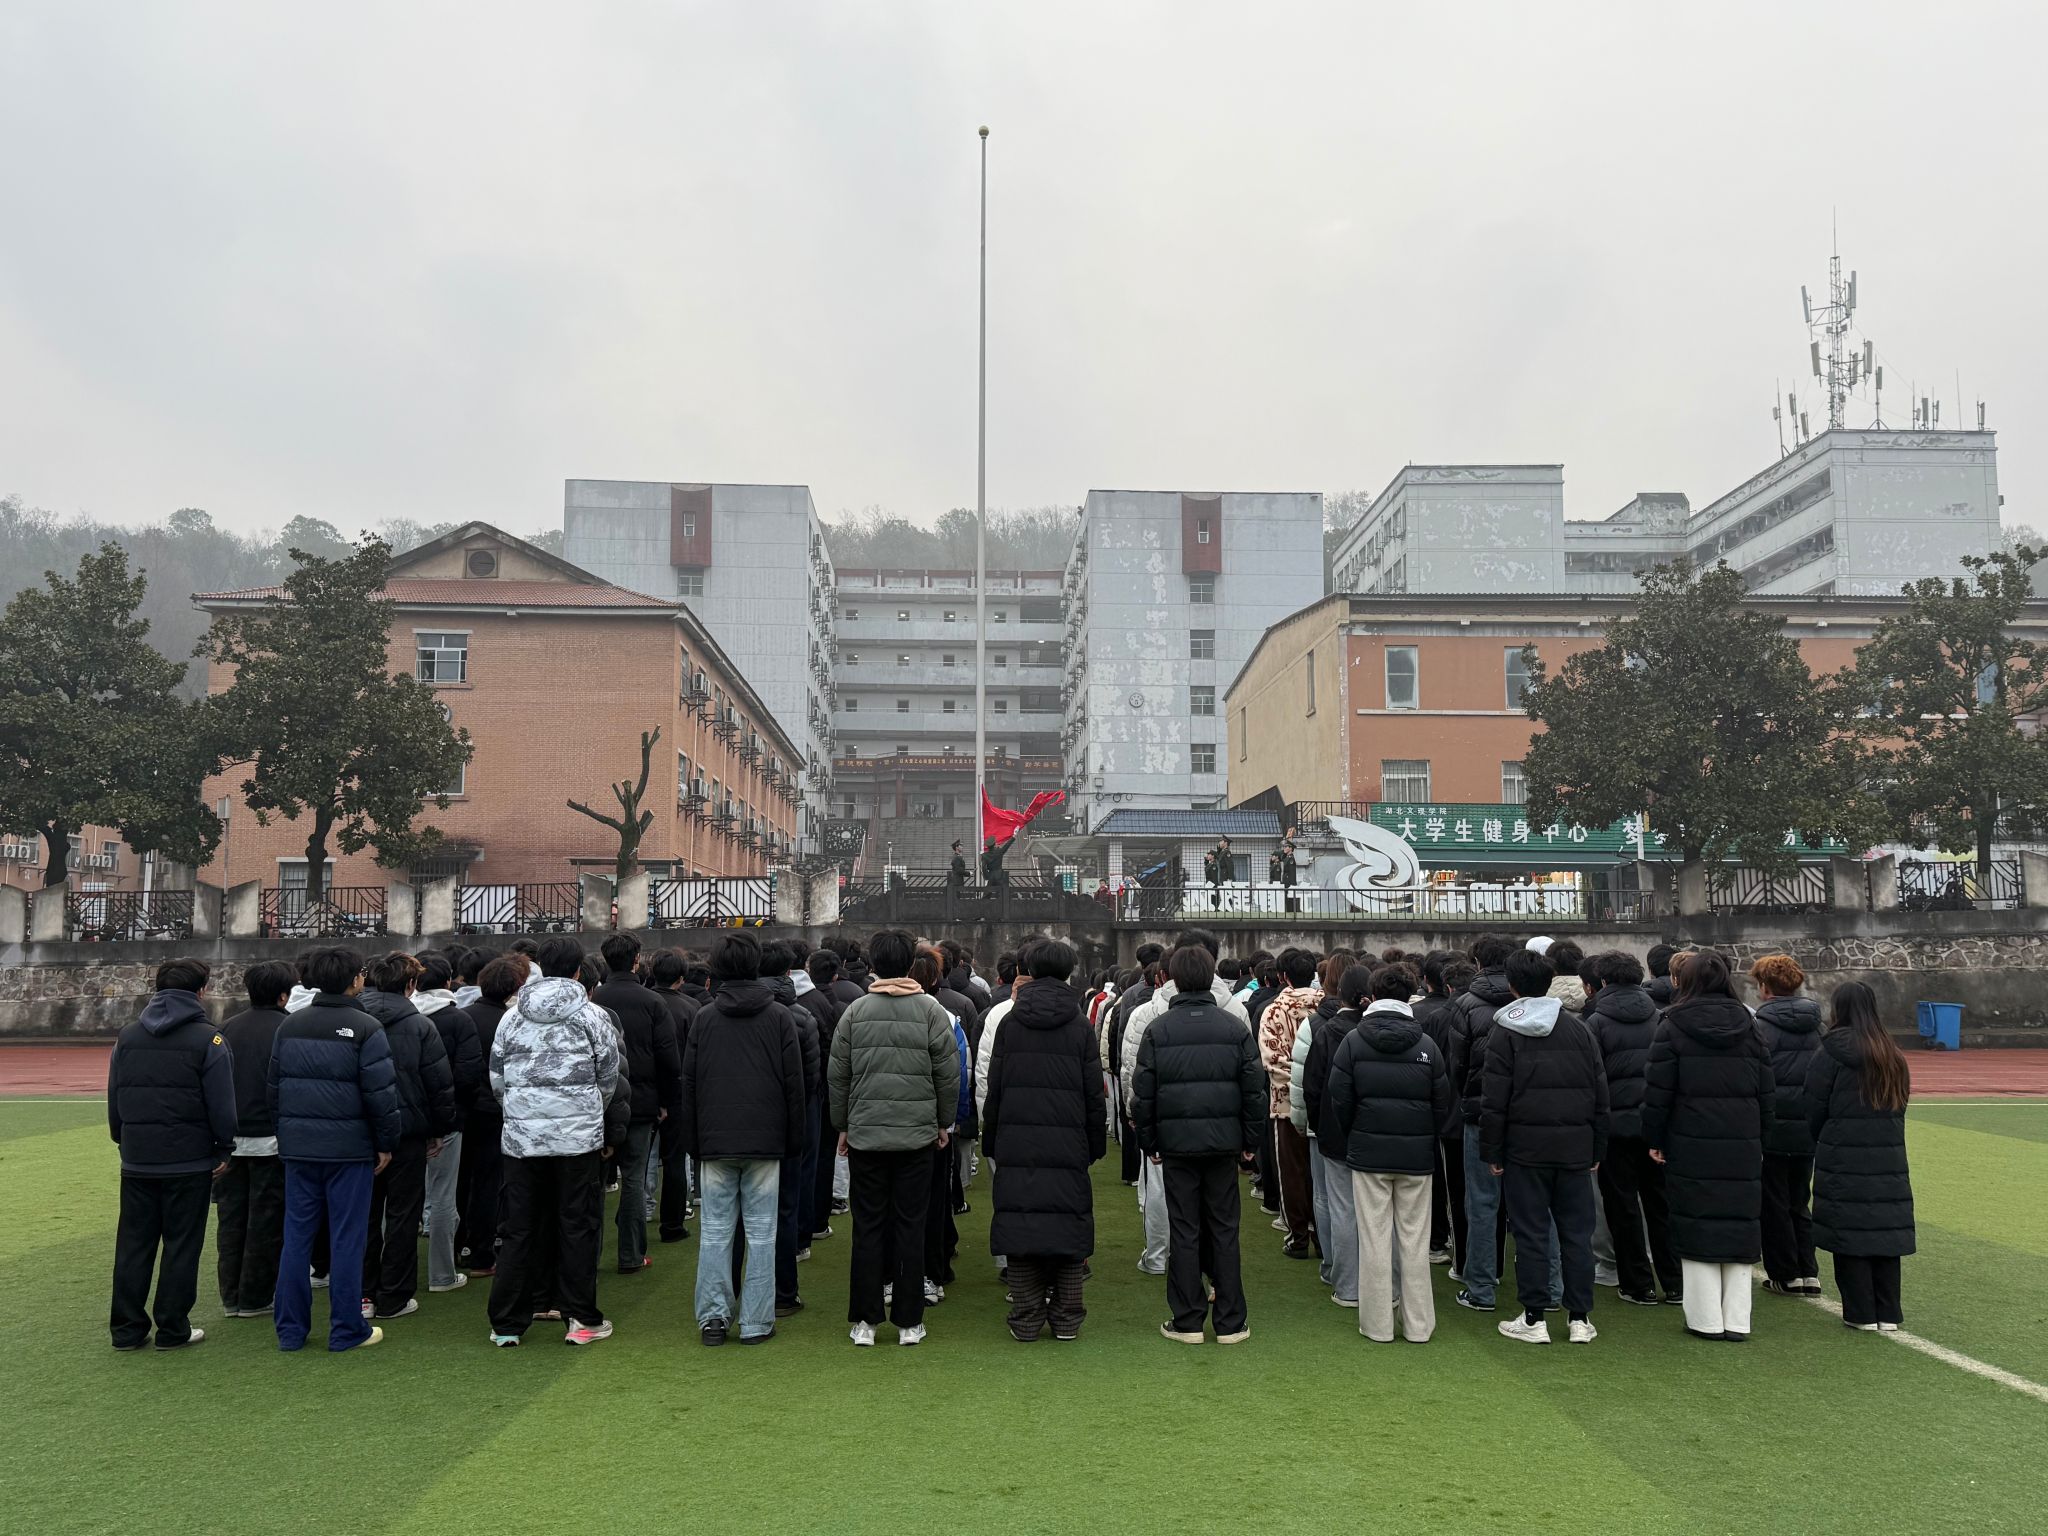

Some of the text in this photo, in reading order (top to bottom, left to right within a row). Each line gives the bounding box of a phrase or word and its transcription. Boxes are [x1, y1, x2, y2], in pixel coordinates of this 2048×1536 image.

[1384, 806, 1448, 815] 湖北文理学院
[1397, 817, 1589, 844] 大学生健身中心
